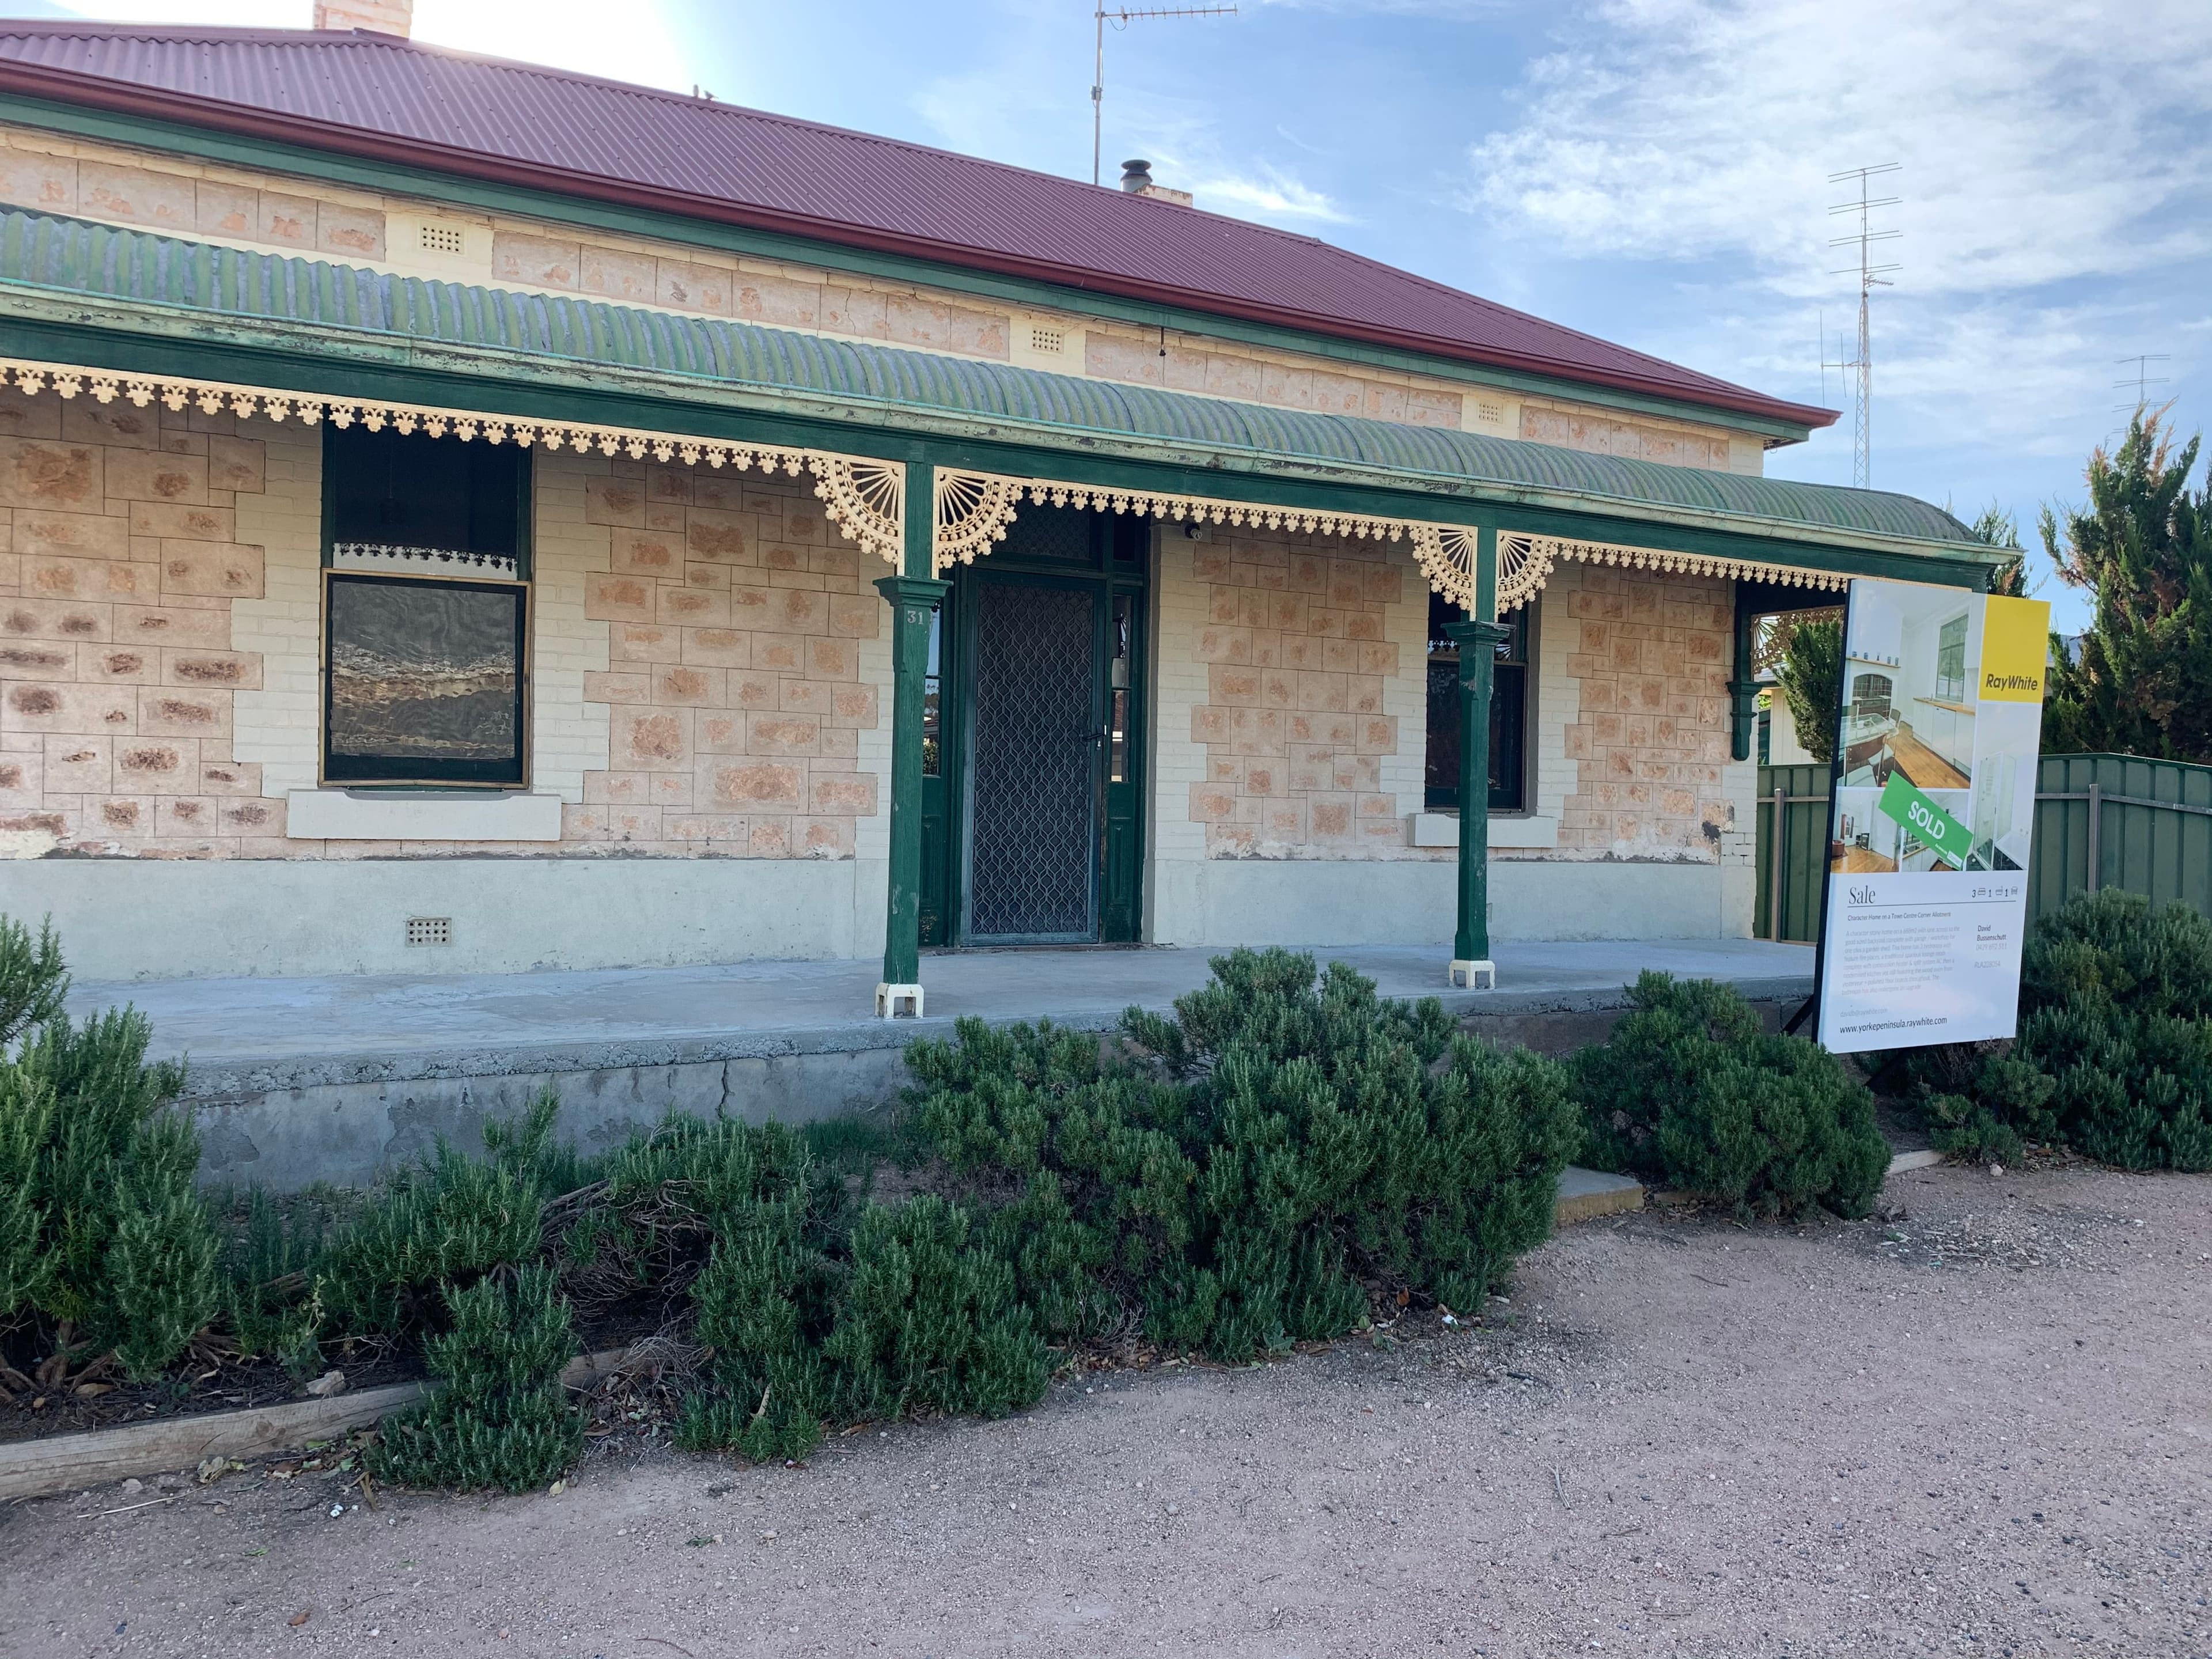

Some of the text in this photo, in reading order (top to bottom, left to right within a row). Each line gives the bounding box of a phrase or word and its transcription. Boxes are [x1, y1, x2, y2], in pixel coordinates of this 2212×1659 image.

[907, 610, 924, 624] 31
[1986, 673, 2038, 691] RayWhite
[1908, 801, 1945, 839] SOLD
[1849, 885, 1876, 904] Sale
[1972, 888, 2008, 898] 3 1 1
[1840, 1017, 1947, 1033] www.yorkepeninsula.raywhite.com
